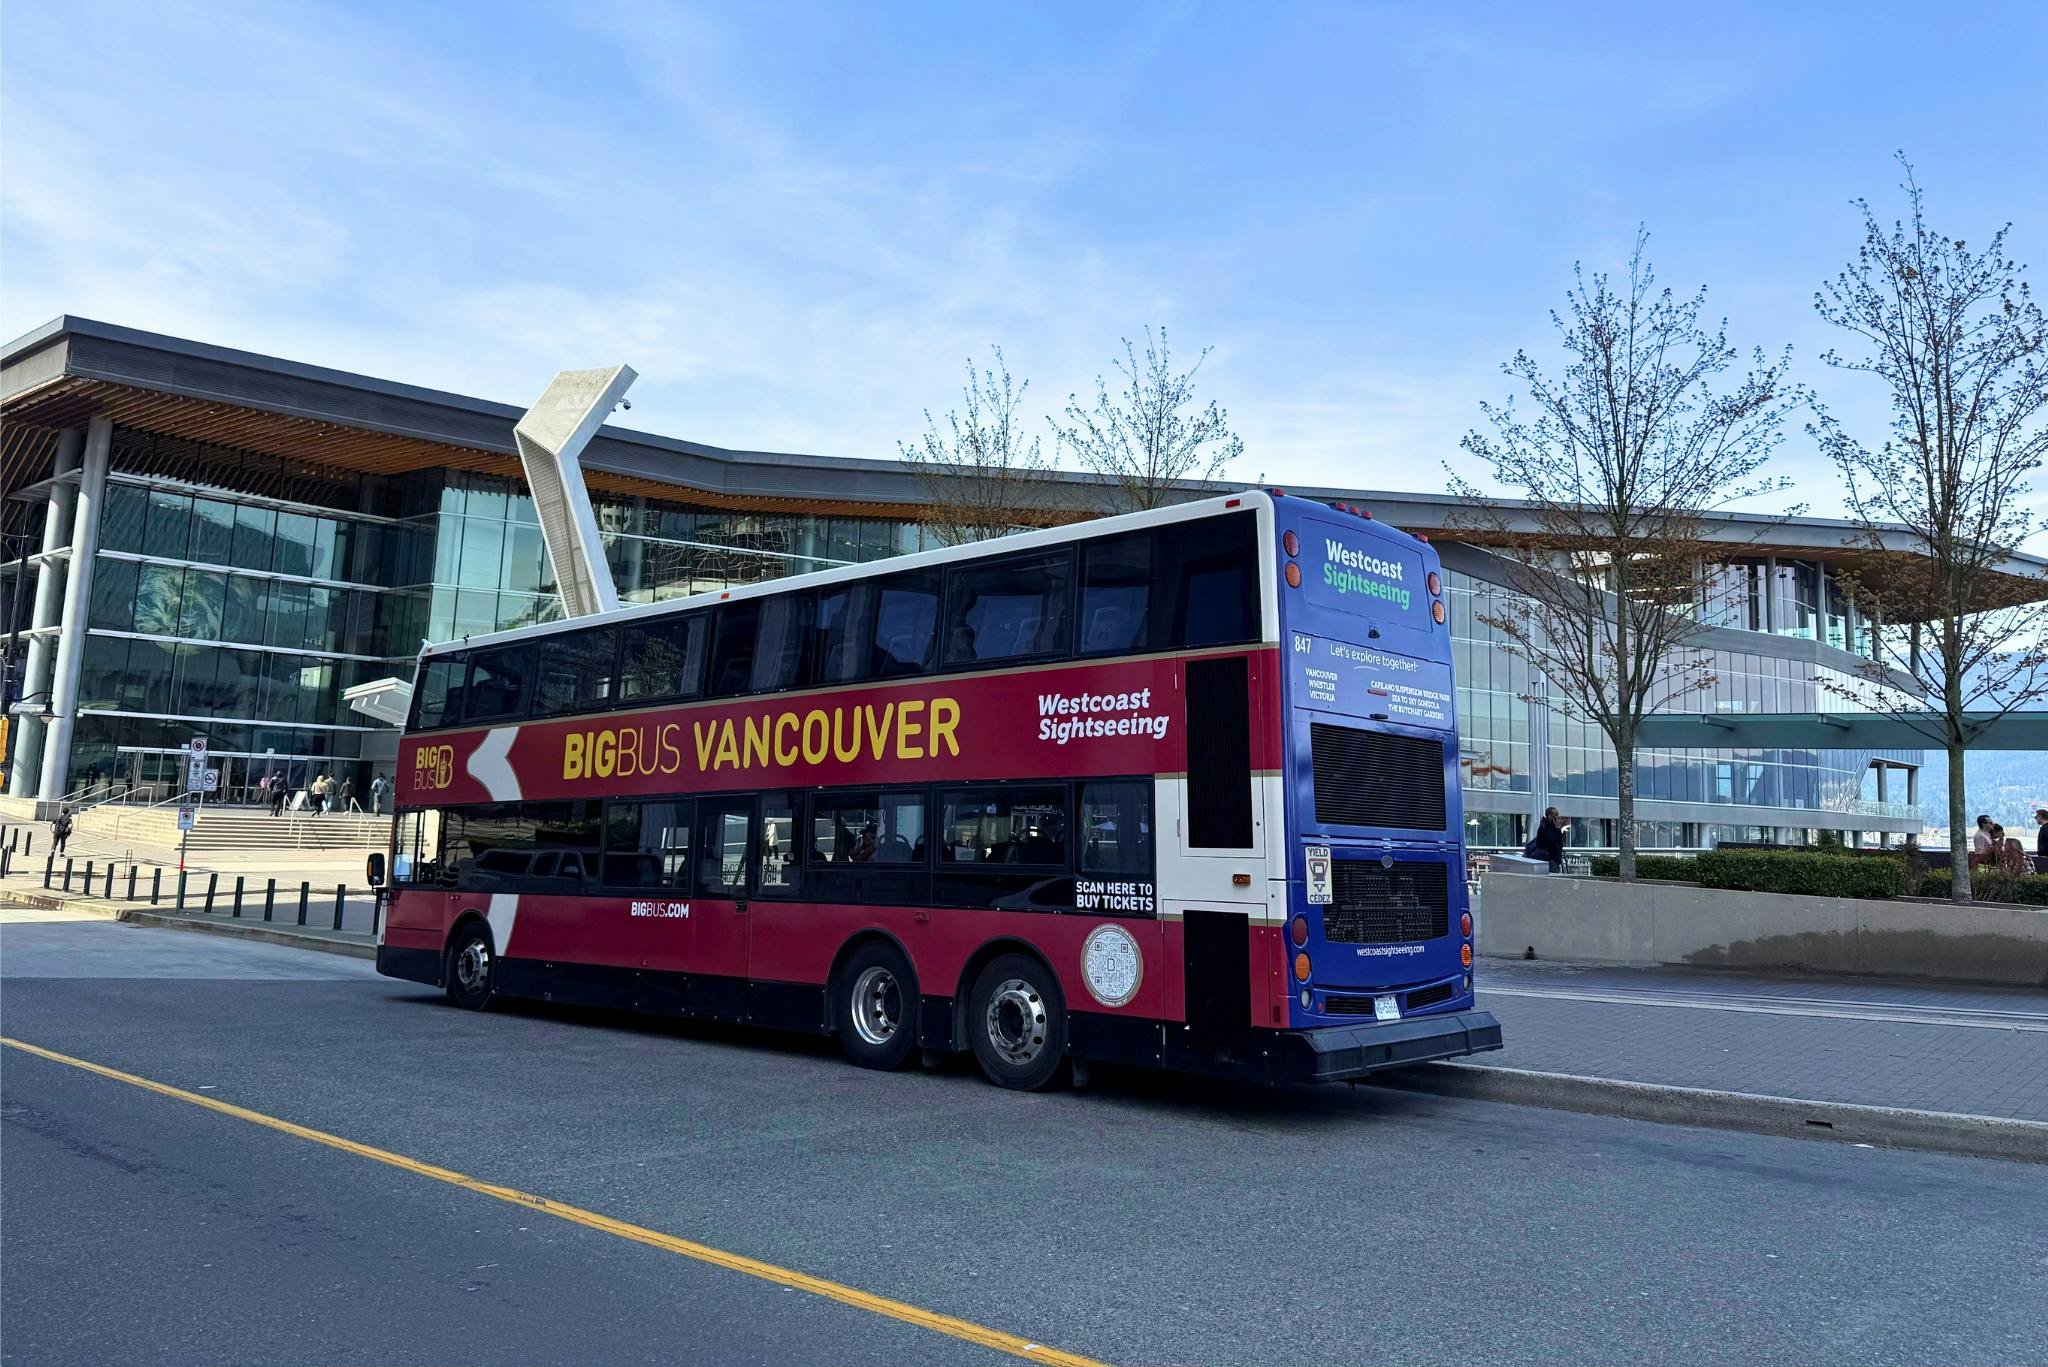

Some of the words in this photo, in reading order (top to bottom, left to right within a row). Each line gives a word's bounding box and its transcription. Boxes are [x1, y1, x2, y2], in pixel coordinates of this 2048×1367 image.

[1325, 538, 1403, 581] Westcoast
[1323, 562, 1411, 610] Sightseeing
[1294, 635, 1312, 654] 847
[1330, 643, 1350, 659] Let's
[1351, 649, 1381, 665] explore
[1304, 667, 1338, 681] VANCOUVER
[1308, 679, 1336, 692] WHISTLER
[1395, 684, 1423, 697] SUSPENSION
[1038, 687, 1151, 716] Westcoast
[1309, 690, 1336, 702] VICTORIA
[1391, 694, 1401, 703] SEA
[694, 697, 961, 772] VANCOUVER
[1038, 712, 1170, 745] Sightseeing
[416, 746, 438, 769] BIG
[414, 769, 436, 790] BUS
[1307, 848, 1329, 857] YIELD
[1076, 881, 1105, 894] SCAN
[1107, 882, 1136, 896] HERE
[1138, 883, 1153, 896] TO
[631, 901, 690, 919] BIGBUS.COM
[1076, 894, 1101, 909] BUY
[1102, 895, 1154, 911] TICKETS
[1356, 944, 1425, 957] westcoastsightseeing.com
